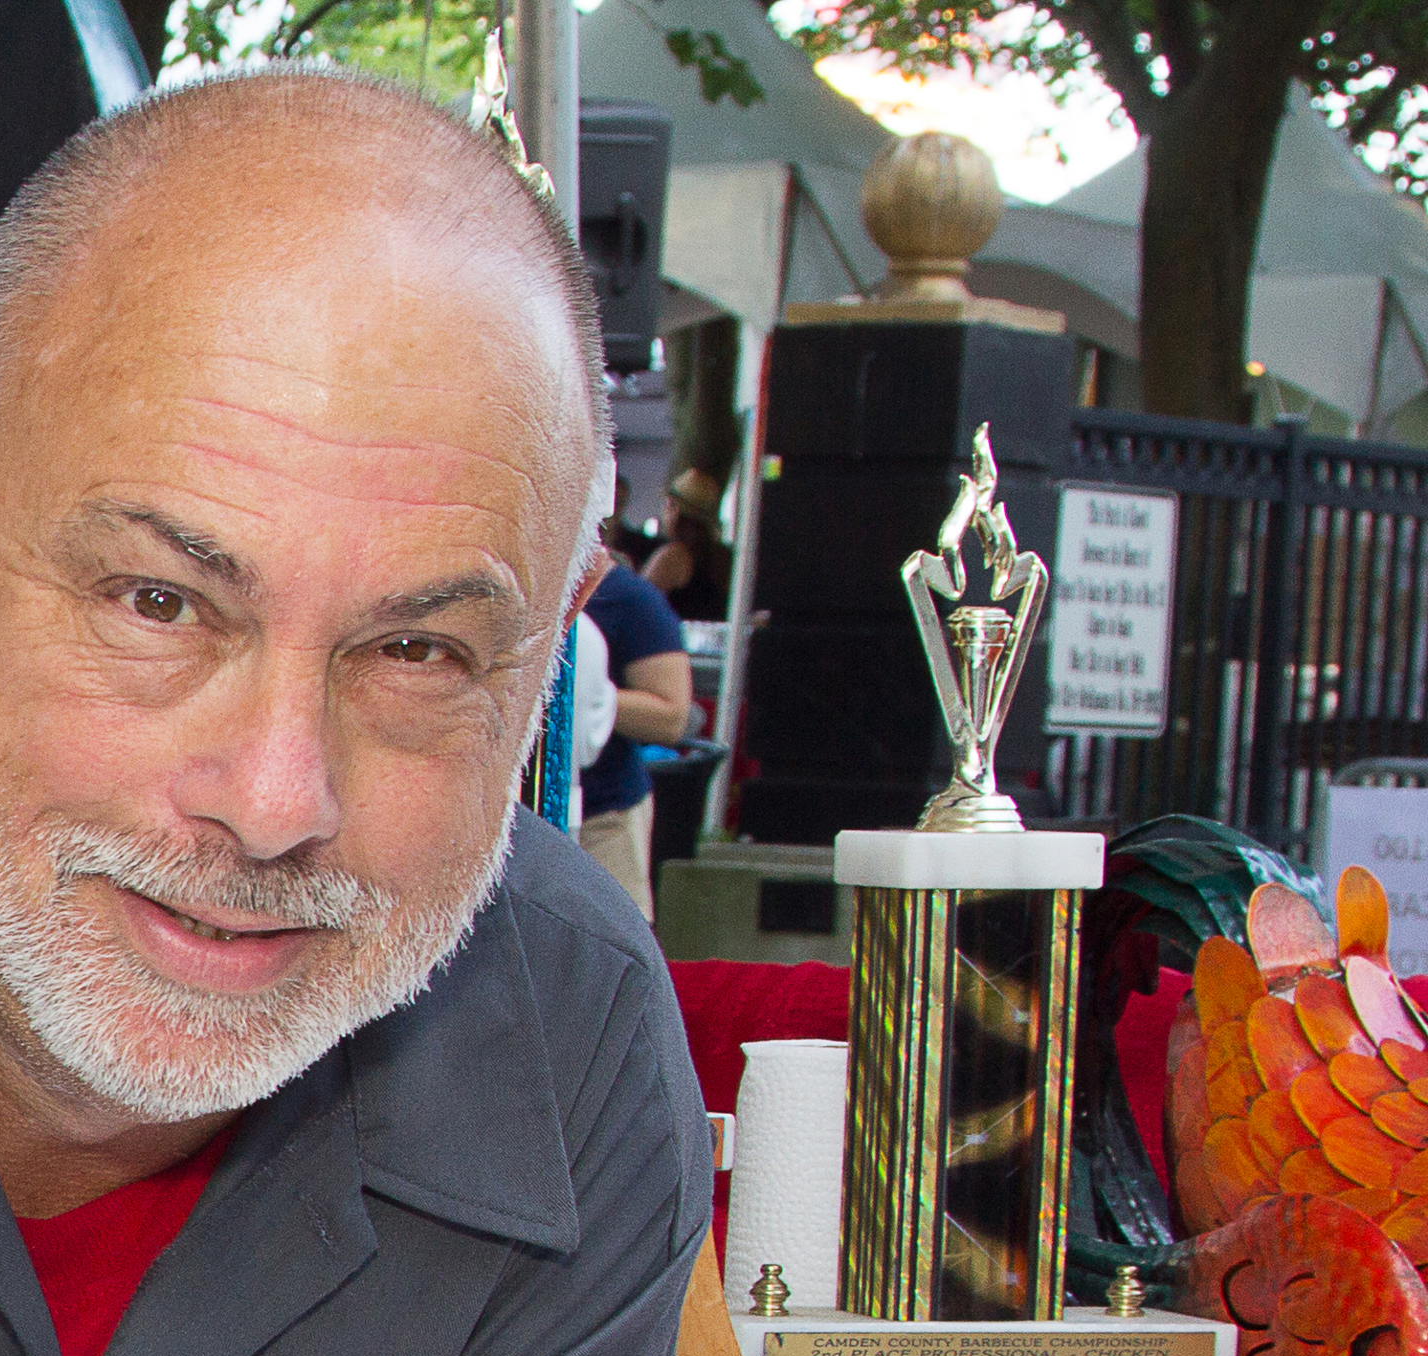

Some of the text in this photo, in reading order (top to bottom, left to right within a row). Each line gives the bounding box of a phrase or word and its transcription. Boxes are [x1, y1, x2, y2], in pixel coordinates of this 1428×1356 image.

[813, 1337, 1169, 1348] CAMDEN COUNTY BARBECUE CHAMPIONSHIP
